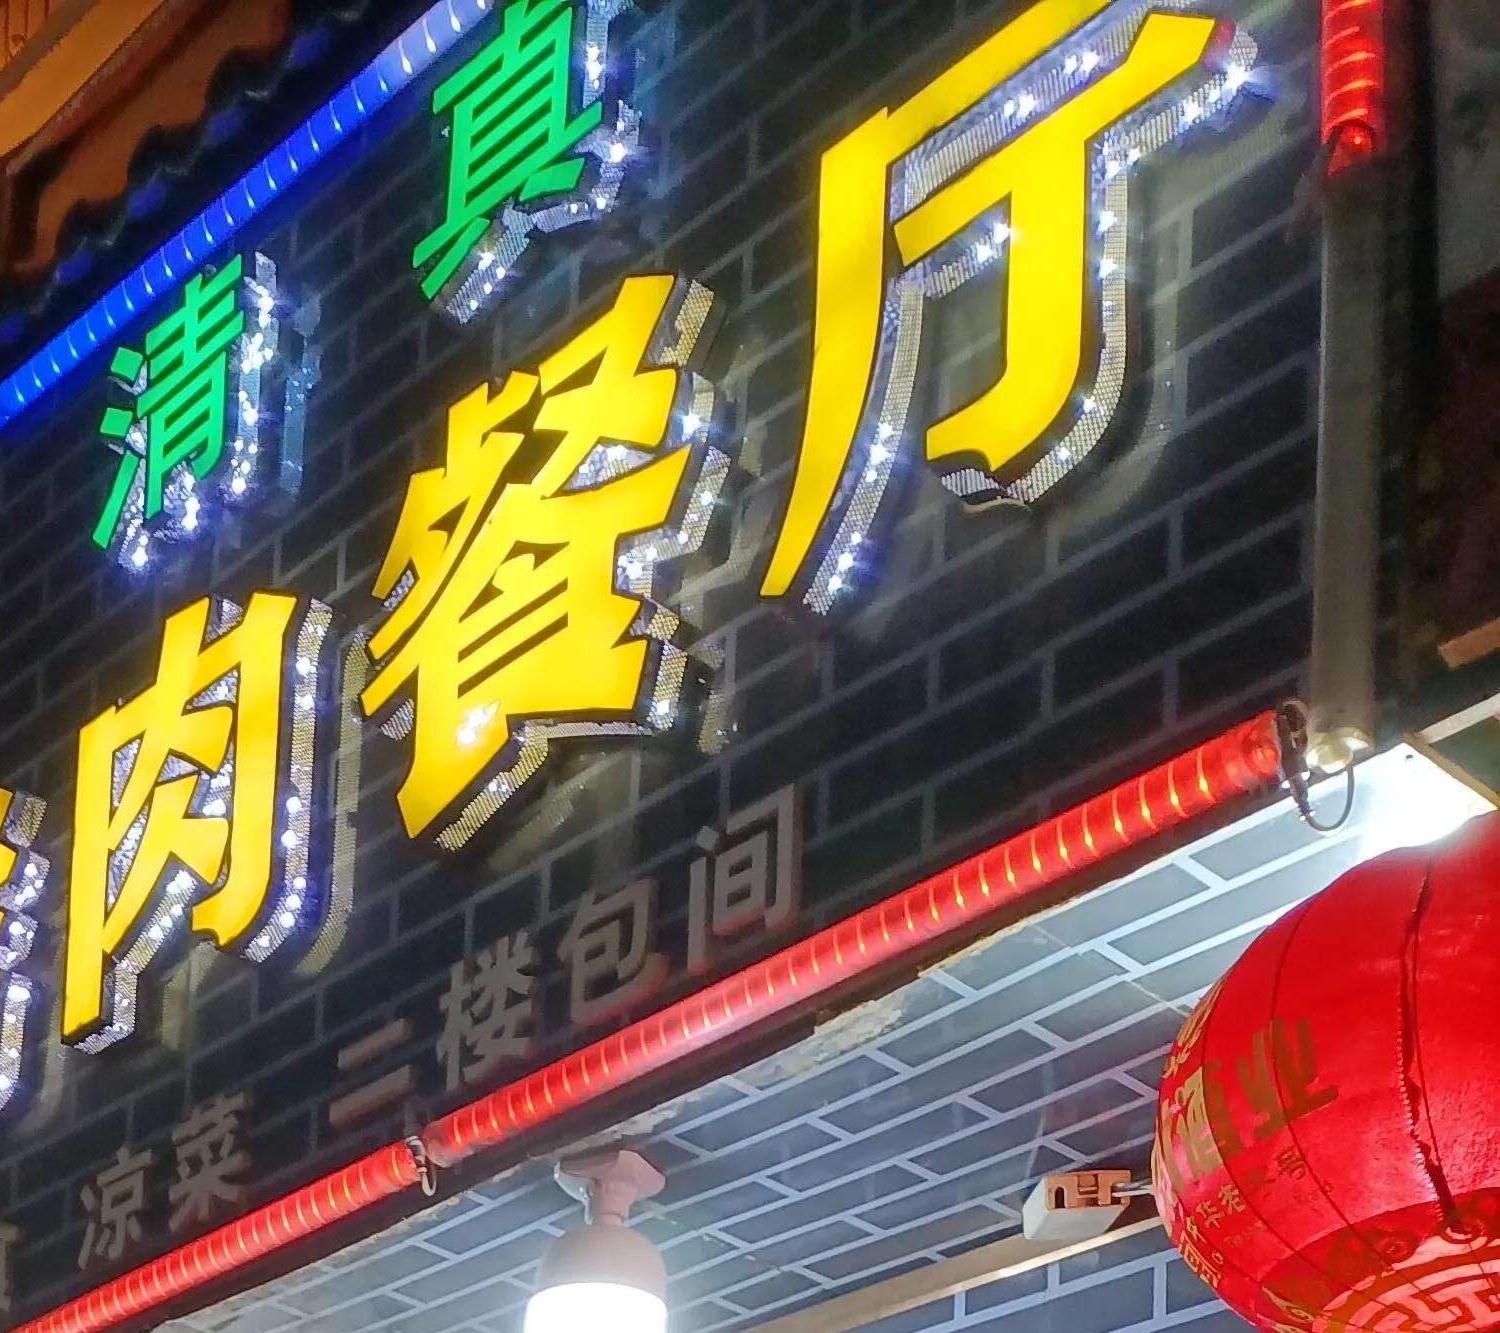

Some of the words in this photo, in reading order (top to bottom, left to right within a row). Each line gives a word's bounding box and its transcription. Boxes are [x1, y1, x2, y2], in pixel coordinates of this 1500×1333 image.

[76, 1090, 258, 1274] 凉菜
[328, 784, 796, 1132] 二楼包间
